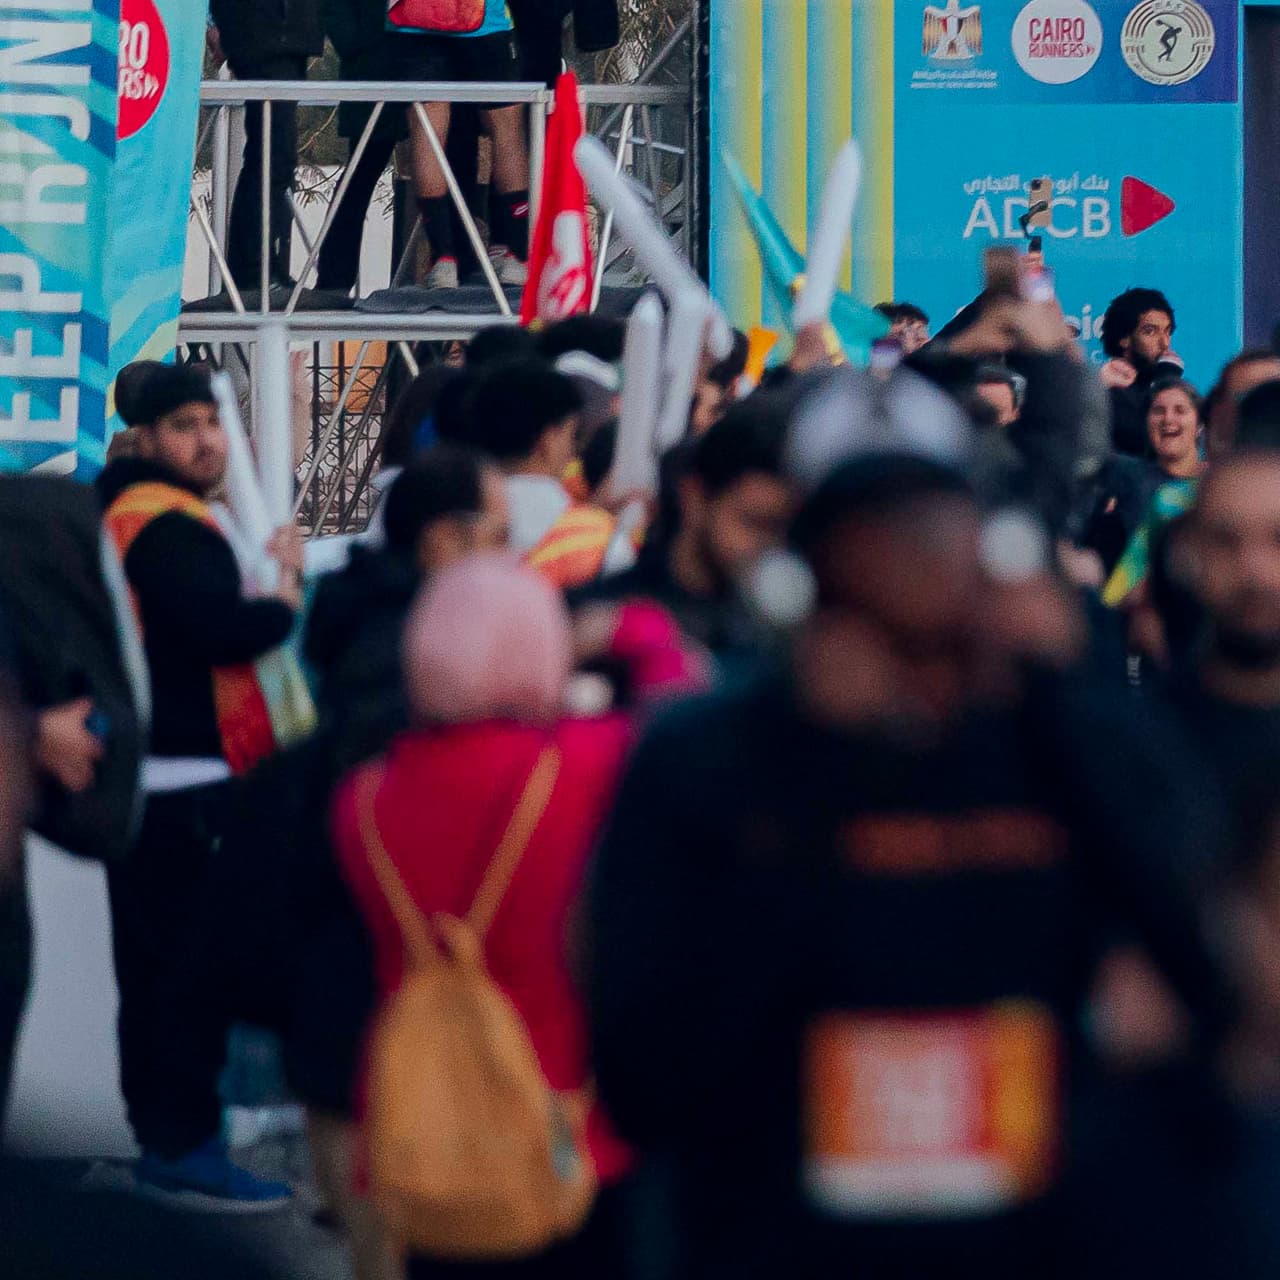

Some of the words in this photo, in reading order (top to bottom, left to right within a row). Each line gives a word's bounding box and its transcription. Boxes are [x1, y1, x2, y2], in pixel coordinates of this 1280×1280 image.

[1029, 17, 1086, 43] CAIRO
[1028, 43, 1084, 58] RUNNERS
[963, 173, 1020, 195] التجاري
[1080, 174, 1109, 194] بنك
[962, 196, 1111, 239] ADCB
[0, 252, 83, 475] EEP
